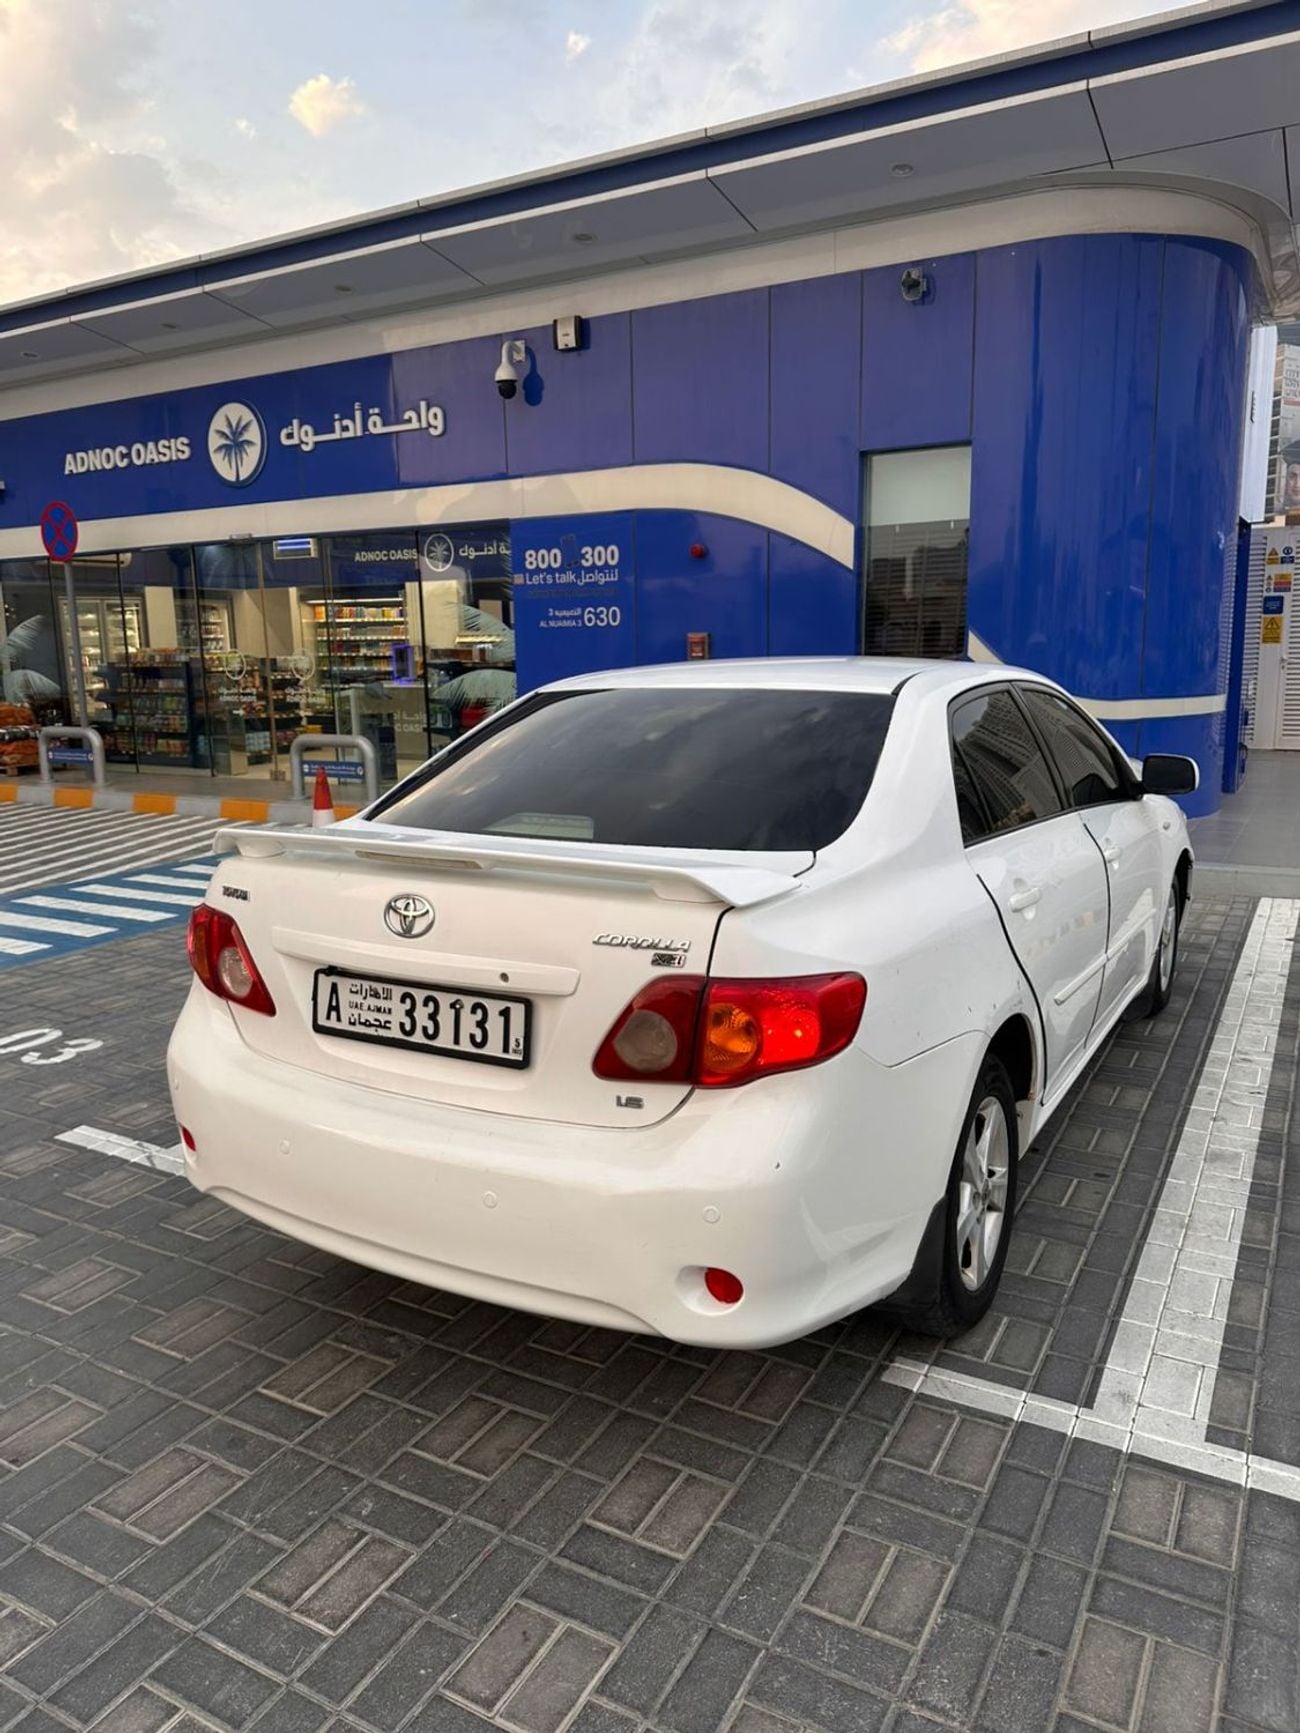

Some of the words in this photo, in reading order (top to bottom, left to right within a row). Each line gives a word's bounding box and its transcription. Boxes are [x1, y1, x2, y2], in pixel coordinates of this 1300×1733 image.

[280, 402, 363, 452] أدنوك
[364, 400, 445, 436] واحة
[64, 448, 131, 476] ADNOC
[131, 436, 192, 465] OASIS
[354, 550, 389, 563] ADNOC
[389, 549, 418, 561] OASIS
[525, 548, 562, 570] 800
[581, 545, 619, 567] 300
[525, 571, 554, 585] Let's
[555, 570, 577, 584] talk
[583, 606, 621, 627] 630
[591, 933, 692, 953] COROLLA
[325, 981, 342, 1023] A
[399, 991, 512, 1054] 33131
[366, 1003, 393, 1016] AJMAN
[348, 1012, 393, 1033] عجمان
